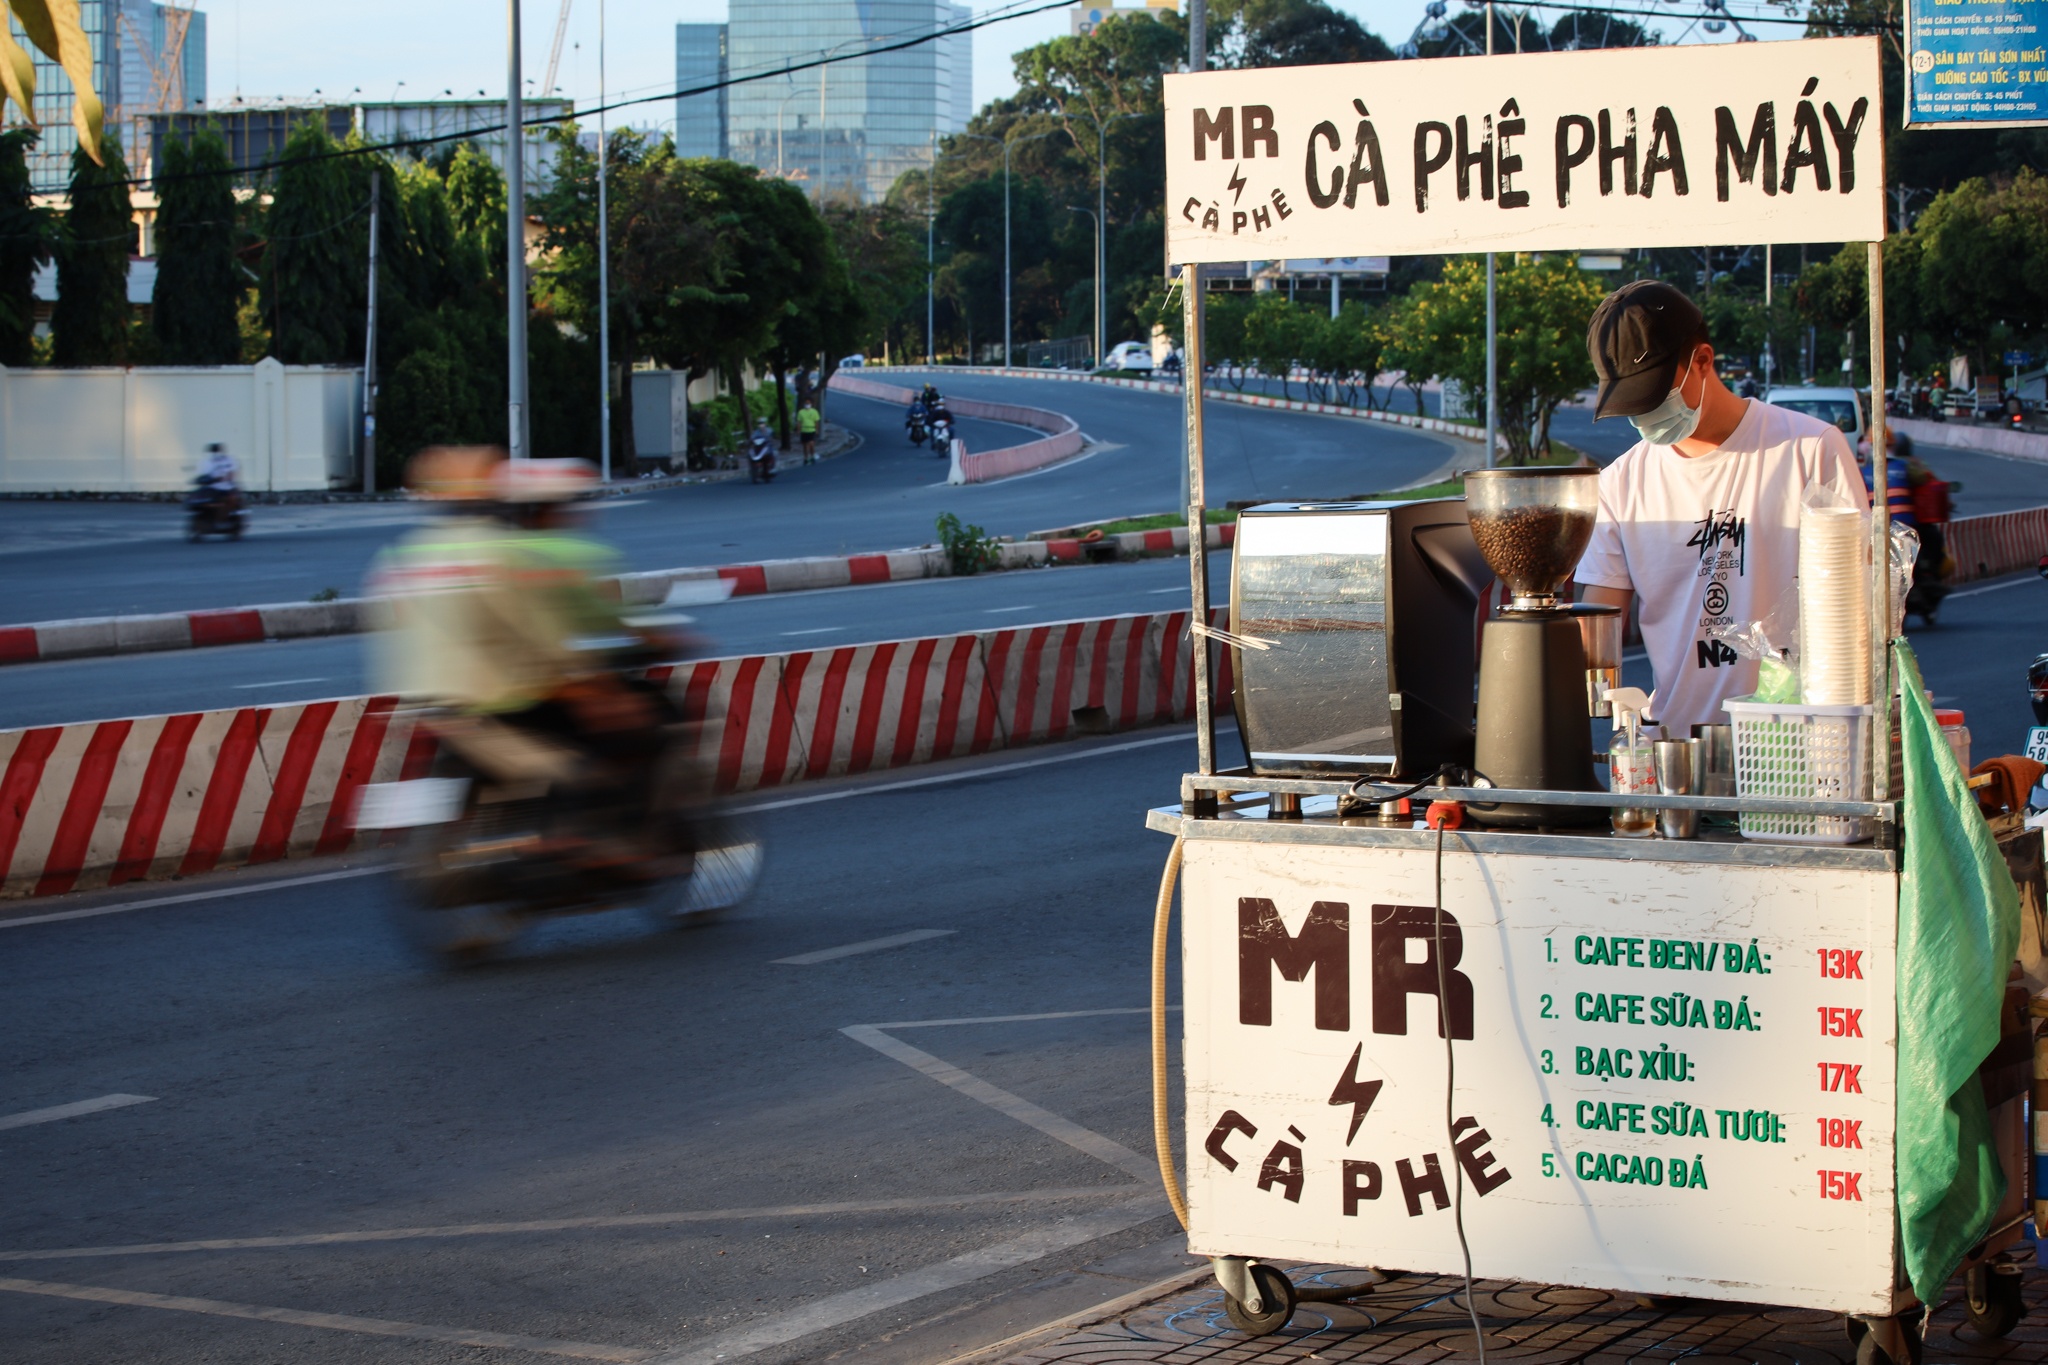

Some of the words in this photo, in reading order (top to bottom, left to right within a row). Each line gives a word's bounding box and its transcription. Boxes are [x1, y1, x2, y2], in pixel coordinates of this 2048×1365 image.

[1934, 28, 1950, 36] GIAN
[1935, 15, 1952, 24] CÁCH
[1914, 56, 1931, 68] 72-1
[1935, 50, 1954, 65] SÂN
[1957, 52, 1975, 64] BAY
[1978, 49, 1996, 64] TÂN
[1999, 50, 2018, 63] SƠN
[2020, 46, 2046, 62] NHẤT
[1935, 69, 1966, 84] ĐƯỜNG
[1969, 72, 1988, 84] CAO
[1990, 67, 2008, 83] TỐC
[2018, 71, 2031, 82] BX
[1935, 91, 1952, 100] CÁCH
[1193, 104, 1279, 161] MR
[1305, 98, 1390, 210] CÀ
[1414, 97, 1530, 213] PHÊ
[1555, 105, 1689, 209] PHA
[1715, 76, 1868, 202] MÁY
[1183, 196, 1219, 232] CÀ
[1232, 188, 1293, 235] PHÊ
[1713, 559, 1739, 569] GELES
[1716, 551, 1733, 560] ORK
[1700, 616, 1734, 627] LONDON
[2028, 747, 2048, 761] 58
[1238, 897, 1474, 1041] MR
[1544, 938, 1558, 963] 1.
[1575, 935, 1644, 968] CAFE
[1723, 938, 1772, 975] ĐÁ:
[1817, 948, 1864, 980] 13K
[1540, 994, 1559, 1019] 2.
[1575, 992, 1645, 1025] CAFE
[1650, 992, 1708, 1029] SỮA
[1713, 995, 1761, 1031] ĐÁ:
[1817, 1006, 1863, 1038] 15K
[1541, 1049, 1559, 1075] 3.
[1575, 1046, 1632, 1082] BẠC
[1639, 1043, 1695, 1082] XỈU:
[1817, 1062, 1863, 1094] 17K
[1540, 1103, 1560, 1128] 4.
[1576, 1100, 1646, 1133] CAFE
[1651, 1101, 1709, 1138] SỮA
[1715, 1109, 1786, 1143] TƯƠI:
[1817, 1118, 1863, 1150] 18K
[1205, 1109, 1306, 1204] CÀ
[1343, 1116, 1512, 1217] PHÊ
[1542, 1153, 1560, 1178] 5.
[1576, 1151, 1663, 1186] CACAO
[1668, 1154, 1708, 1190] ĐÁ
[1817, 1170, 1863, 1201] 15K
